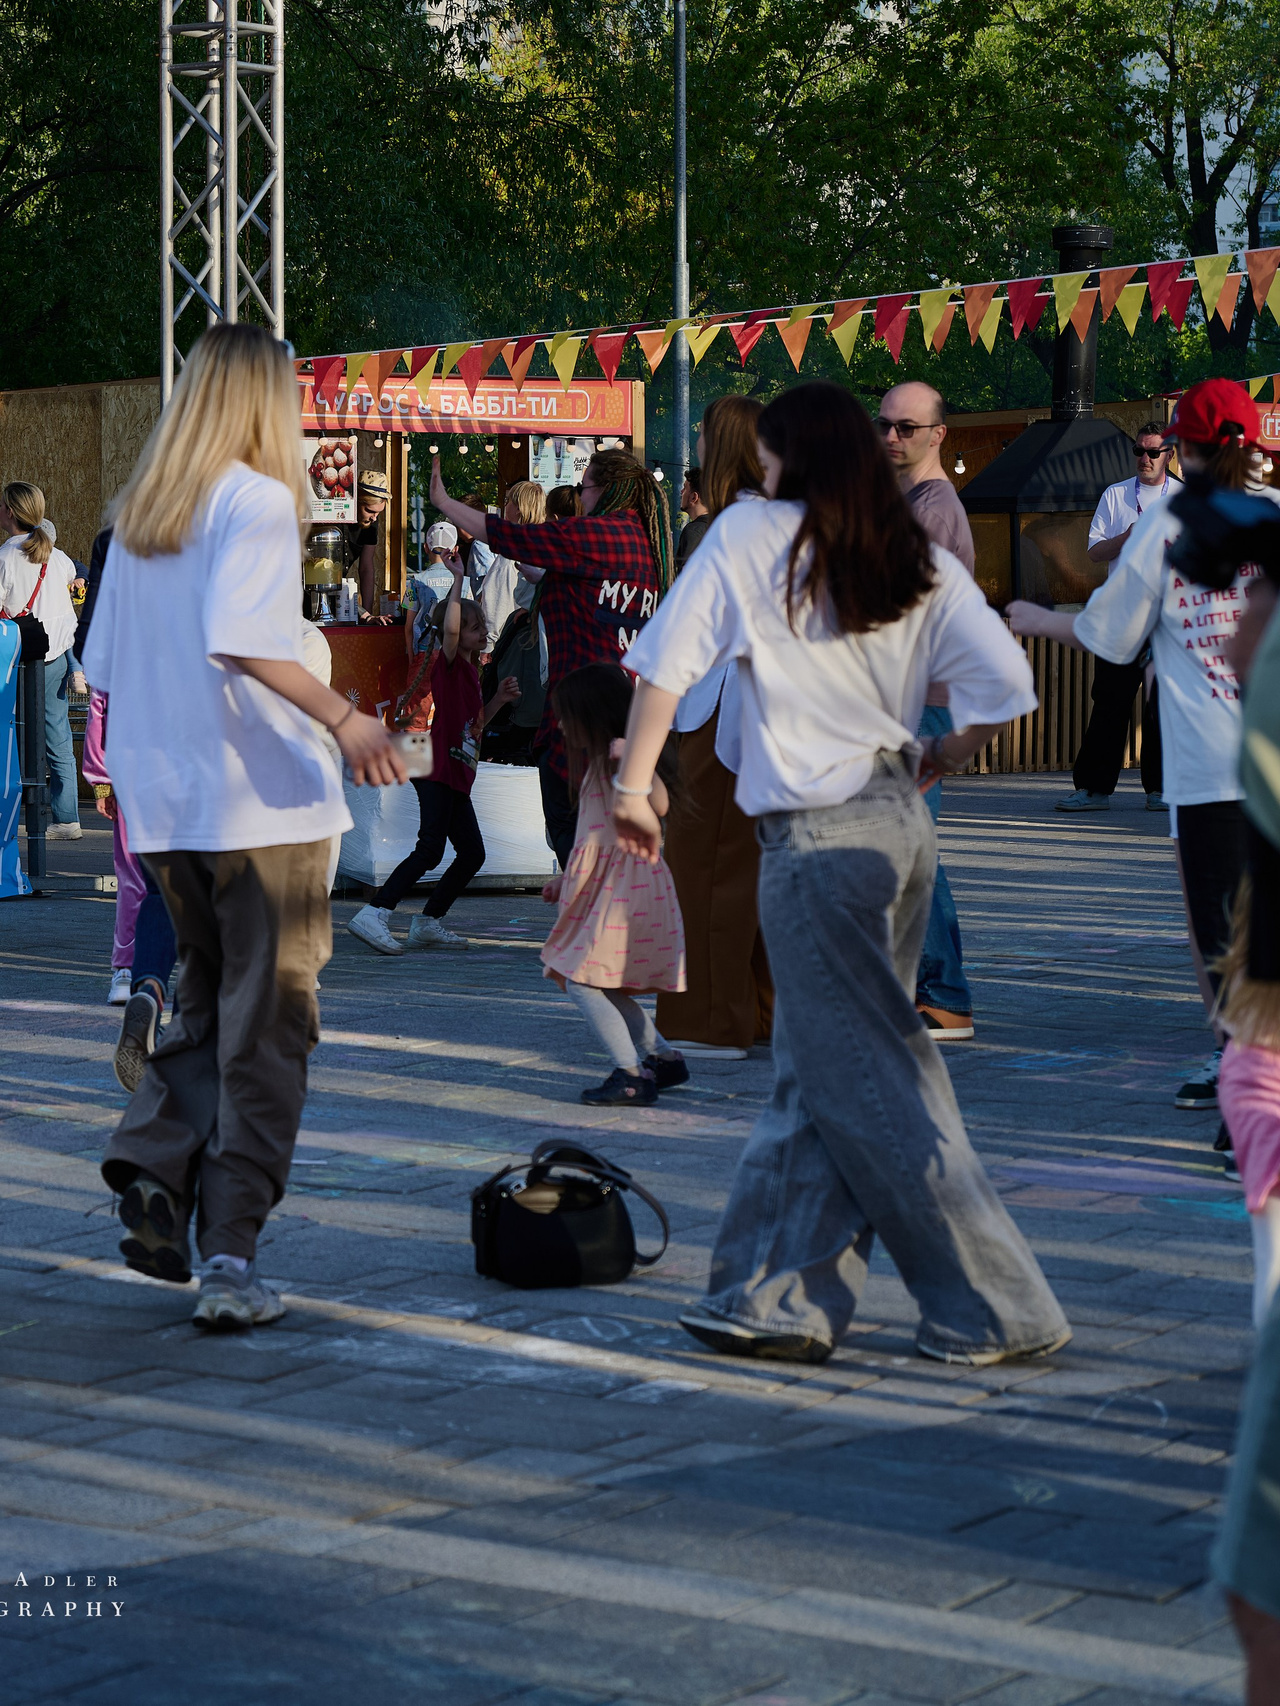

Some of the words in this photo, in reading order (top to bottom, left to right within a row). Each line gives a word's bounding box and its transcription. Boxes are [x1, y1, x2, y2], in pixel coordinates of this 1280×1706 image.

[315, 391, 410, 413] ЧУРРОС
[440, 394, 557, 416] БАББЛ-ТИ
[1173, 577, 1184, 590] A
[598, 579, 638, 614] MY
[1178, 597, 1188, 610] A
[1192, 587, 1240, 607] LITTLE
[1183, 618, 1193, 630] A
[1196, 610, 1241, 628] LITTLE
[1186, 639, 1194, 650] A
